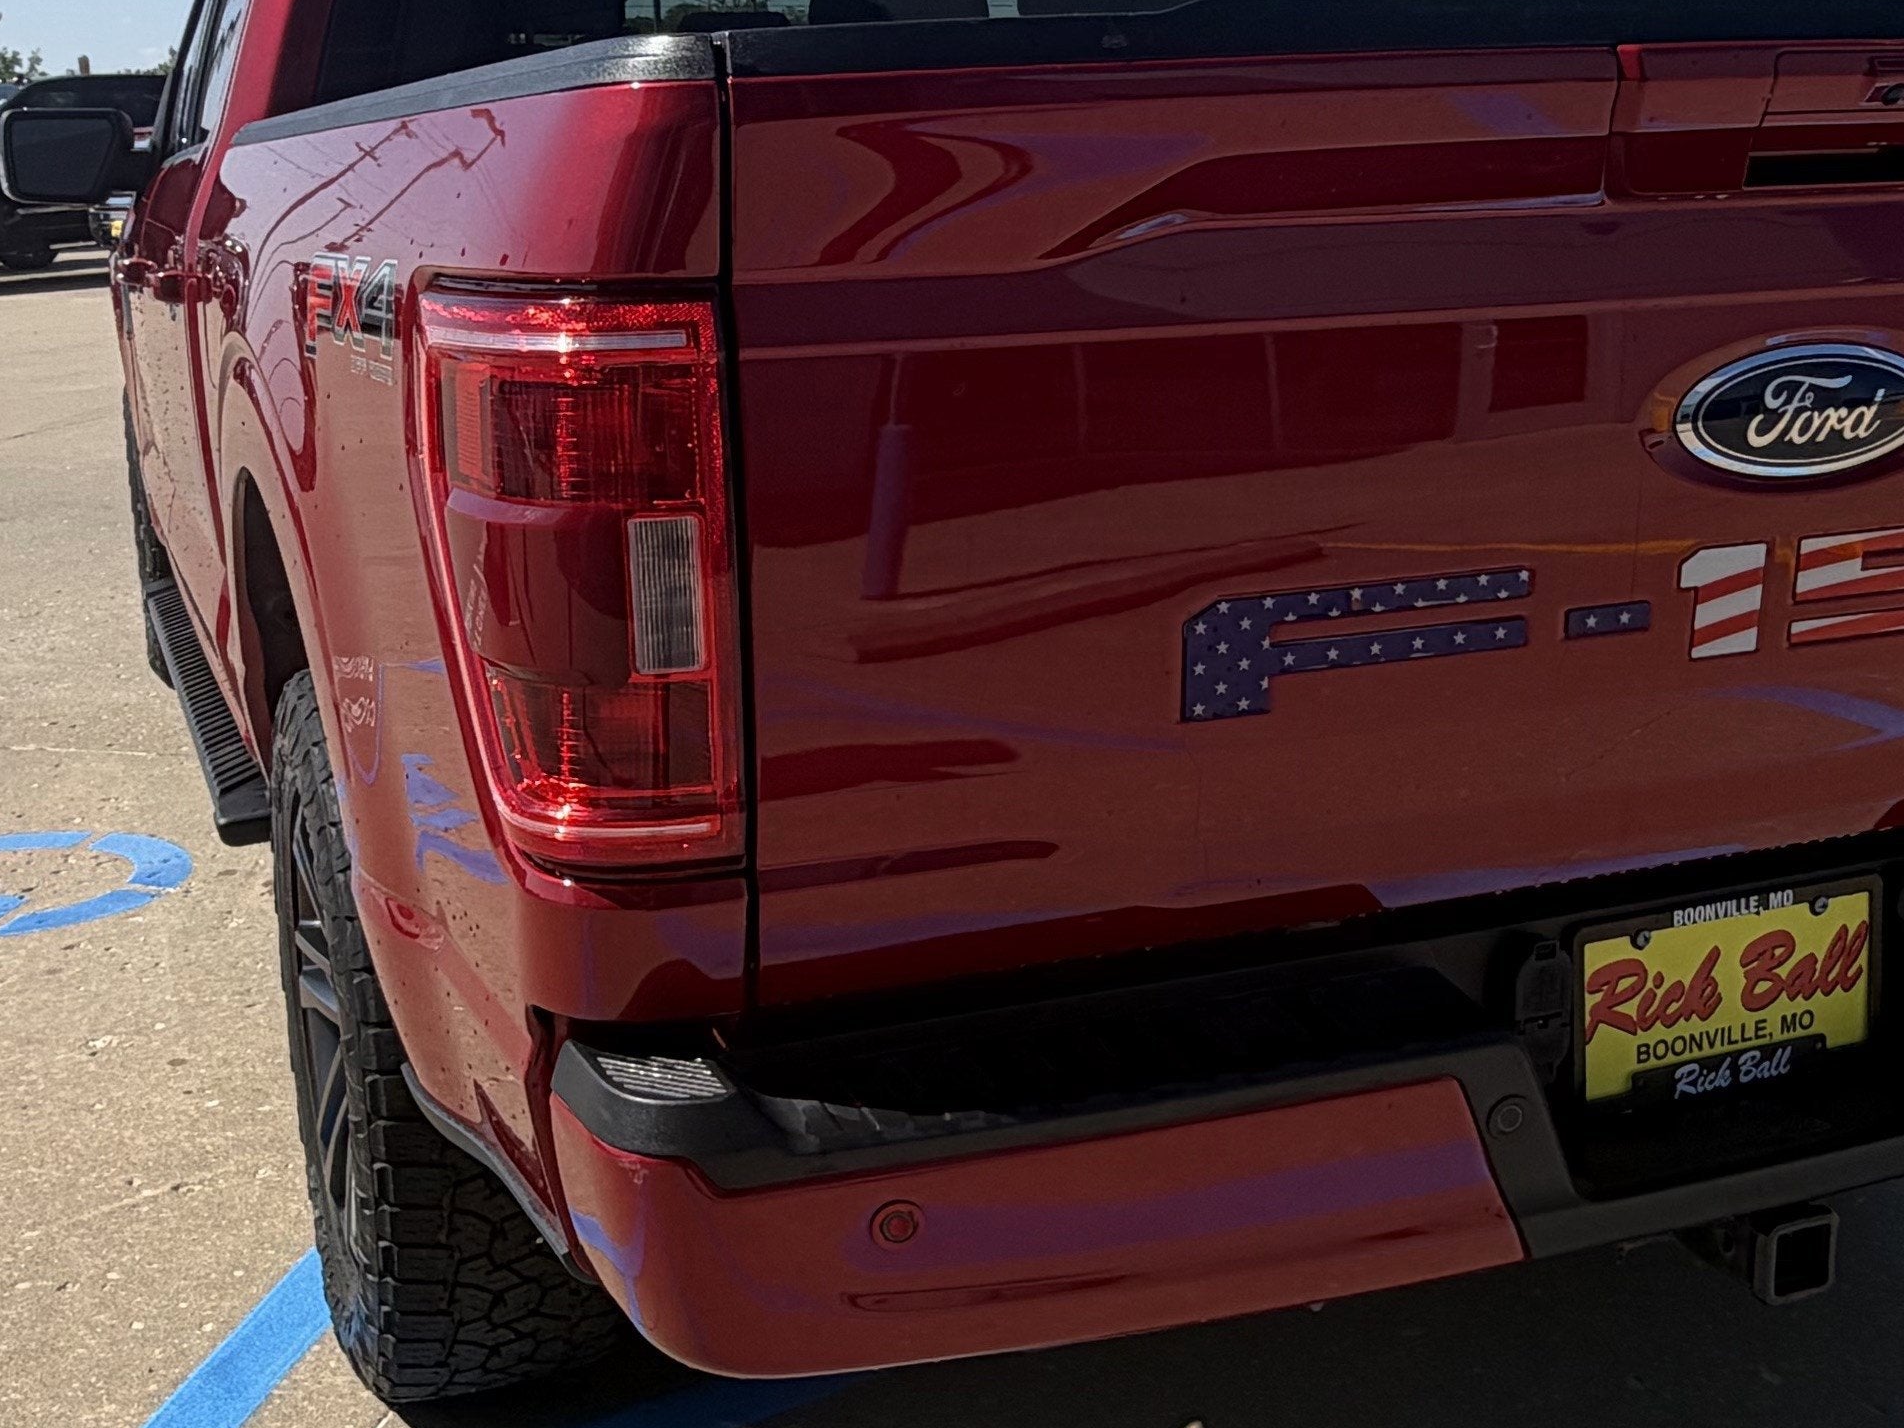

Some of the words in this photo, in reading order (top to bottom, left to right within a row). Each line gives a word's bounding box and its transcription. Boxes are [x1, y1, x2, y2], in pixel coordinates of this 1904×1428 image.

[304, 252, 399, 361] FX4
[1746, 374, 1885, 448] Ford
[1673, 895, 1765, 928] BOONVILLE,
[1768, 889, 1794, 911] MO
[1584, 945, 1723, 1045] Rick
[1739, 919, 1869, 1013] Ball
[1636, 1018, 1774, 1065] BOONVILLE,
[1780, 1009, 1815, 1035] MO
[1674, 1057, 1732, 1100] Rick
[1738, 1046, 1791, 1083] Ball
